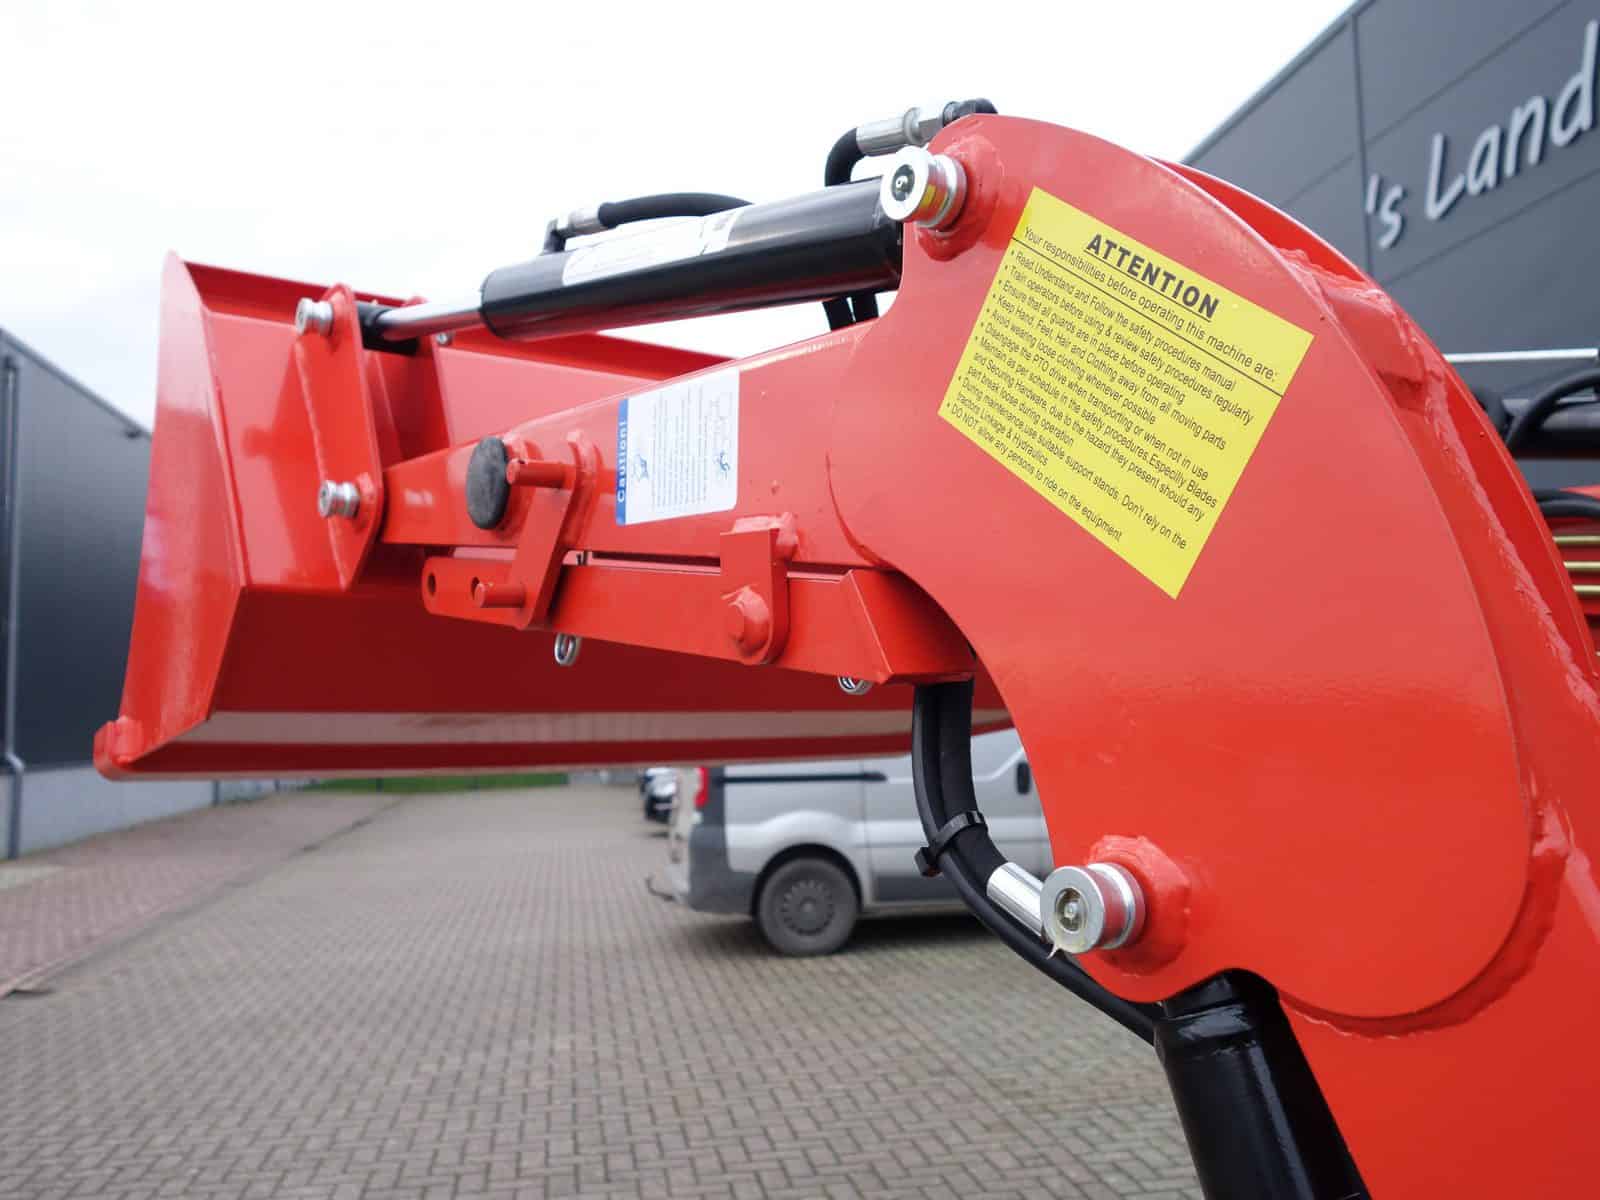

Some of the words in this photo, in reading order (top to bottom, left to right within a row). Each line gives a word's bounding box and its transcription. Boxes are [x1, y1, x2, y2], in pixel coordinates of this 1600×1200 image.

[1087, 235, 1220, 318] ATTENTION
[1366, 173, 1404, 249] 's
[1003, 280, 1025, 302] Ensure
[1026, 295, 1042, 311] that
[1042, 307, 1051, 317] all
[1050, 314, 1075, 333] guards
[1077, 330, 1088, 341] are
[1089, 335, 1097, 347] in
[1097, 343, 1118, 360] place
[1120, 354, 1145, 377] before
[1147, 374, 1184, 404] operating
[1011, 266, 1026, 284] Train
[1027, 279, 1059, 304] operators
[1060, 297, 1082, 318] before
[1084, 315, 1103, 334] using
[1105, 325, 1113, 337] &
[1112, 332, 1138, 353] review
[1140, 349, 1164, 370] safety
[1163, 364, 1212, 398] procedures
[1213, 394, 1253, 425] regularly
[1025, 227, 1042, 245] Your
[1042, 241, 1105, 282] responsibilities
[1107, 275, 1136, 300] before
[1138, 297, 1183, 329] operating
[1185, 321, 1204, 339] this
[1206, 336, 1251, 367] machine
[1034, 263, 1074, 293] Understand
[1075, 290, 1089, 303] and
[1089, 296, 1114, 318] Follow
[1115, 312, 1128, 326] the
[1130, 323, 1154, 343] safety
[1153, 338, 1200, 370] procedures
[1202, 366, 1236, 391] manual
[956, 391, 979, 414] tractors
[980, 409, 1005, 434] Linkage
[1006, 428, 1013, 439] &
[1012, 433, 1048, 465] Hydraulics
[967, 367, 982, 380] part
[981, 374, 999, 393] break
[999, 388, 1017, 406] loose
[1019, 402, 1039, 424] during
[1041, 420, 1073, 447] operation
[979, 337, 1007, 362] Maintain
[1007, 359, 1015, 368] as
[1015, 364, 1028, 377] per
[1029, 373, 1059, 398] schedule
[1060, 392, 1067, 404] in
[1068, 398, 1080, 413] the
[1082, 410, 1104, 431] safety
[1186, 480, 1216, 507] Blades
[986, 323, 1019, 352] Disengage
[1020, 346, 1031, 360] the
[1032, 354, 1048, 371] PTO
[1049, 366, 1066, 384] drive
[1067, 380, 1087, 398] when
[1087, 391, 1132, 431] transporting
[1134, 426, 1144, 436] or
[1143, 431, 1166, 451] when
[1166, 447, 1183, 462] not
[1182, 455, 1191, 468] in
[1191, 464, 1208, 480] use
[991, 310, 1009, 327] Avoid
[1010, 324, 1035, 347] wearing
[1037, 340, 1056, 358] loose
[1058, 355, 1084, 379] clothing
[1085, 374, 1122, 402] whenever
[1121, 398, 1155, 424] possible
[997, 295, 1014, 314] Keep
[1055, 332, 1070, 349] Hair
[1071, 345, 1085, 358] and
[1087, 353, 1116, 382] Clothing
[1118, 375, 1139, 395] away
[1139, 387, 1159, 407] from
[1160, 402, 1171, 414] all
[1170, 409, 1201, 437] moving
[1201, 430, 1225, 449] parts
[617, 420, 627, 503] Caution!
[952, 405, 961, 418] DO
[962, 412, 978, 429] NOT
[978, 427, 994, 443] allow
[995, 440, 1008, 454] any
[1007, 449, 1034, 473] persons
[1035, 468, 1042, 480] to
[1043, 476, 1057, 491] ride
[1058, 488, 1069, 500] on
[1068, 493, 1081, 509] the
[1082, 506, 1123, 541] equipment
[963, 378, 982, 401] During
[1038, 436, 1064, 459] suitable
[1066, 456, 1094, 480] support
[1122, 495, 1144, 517] Don't
[1143, 512, 1160, 530] rely
[1160, 525, 1172, 538] on
[1171, 531, 1186, 548] the
[974, 353, 986, 364] and
[987, 360, 1013, 387] Securing
[1050, 404, 1062, 419] due
[1063, 413, 1071, 425] to
[1072, 419, 1083, 434] the
[1085, 429, 1111, 453] hazard
[1110, 447, 1129, 467] they
[1127, 462, 1160, 488] present
[1160, 484, 1187, 506] should
[1187, 503, 1205, 521] any
